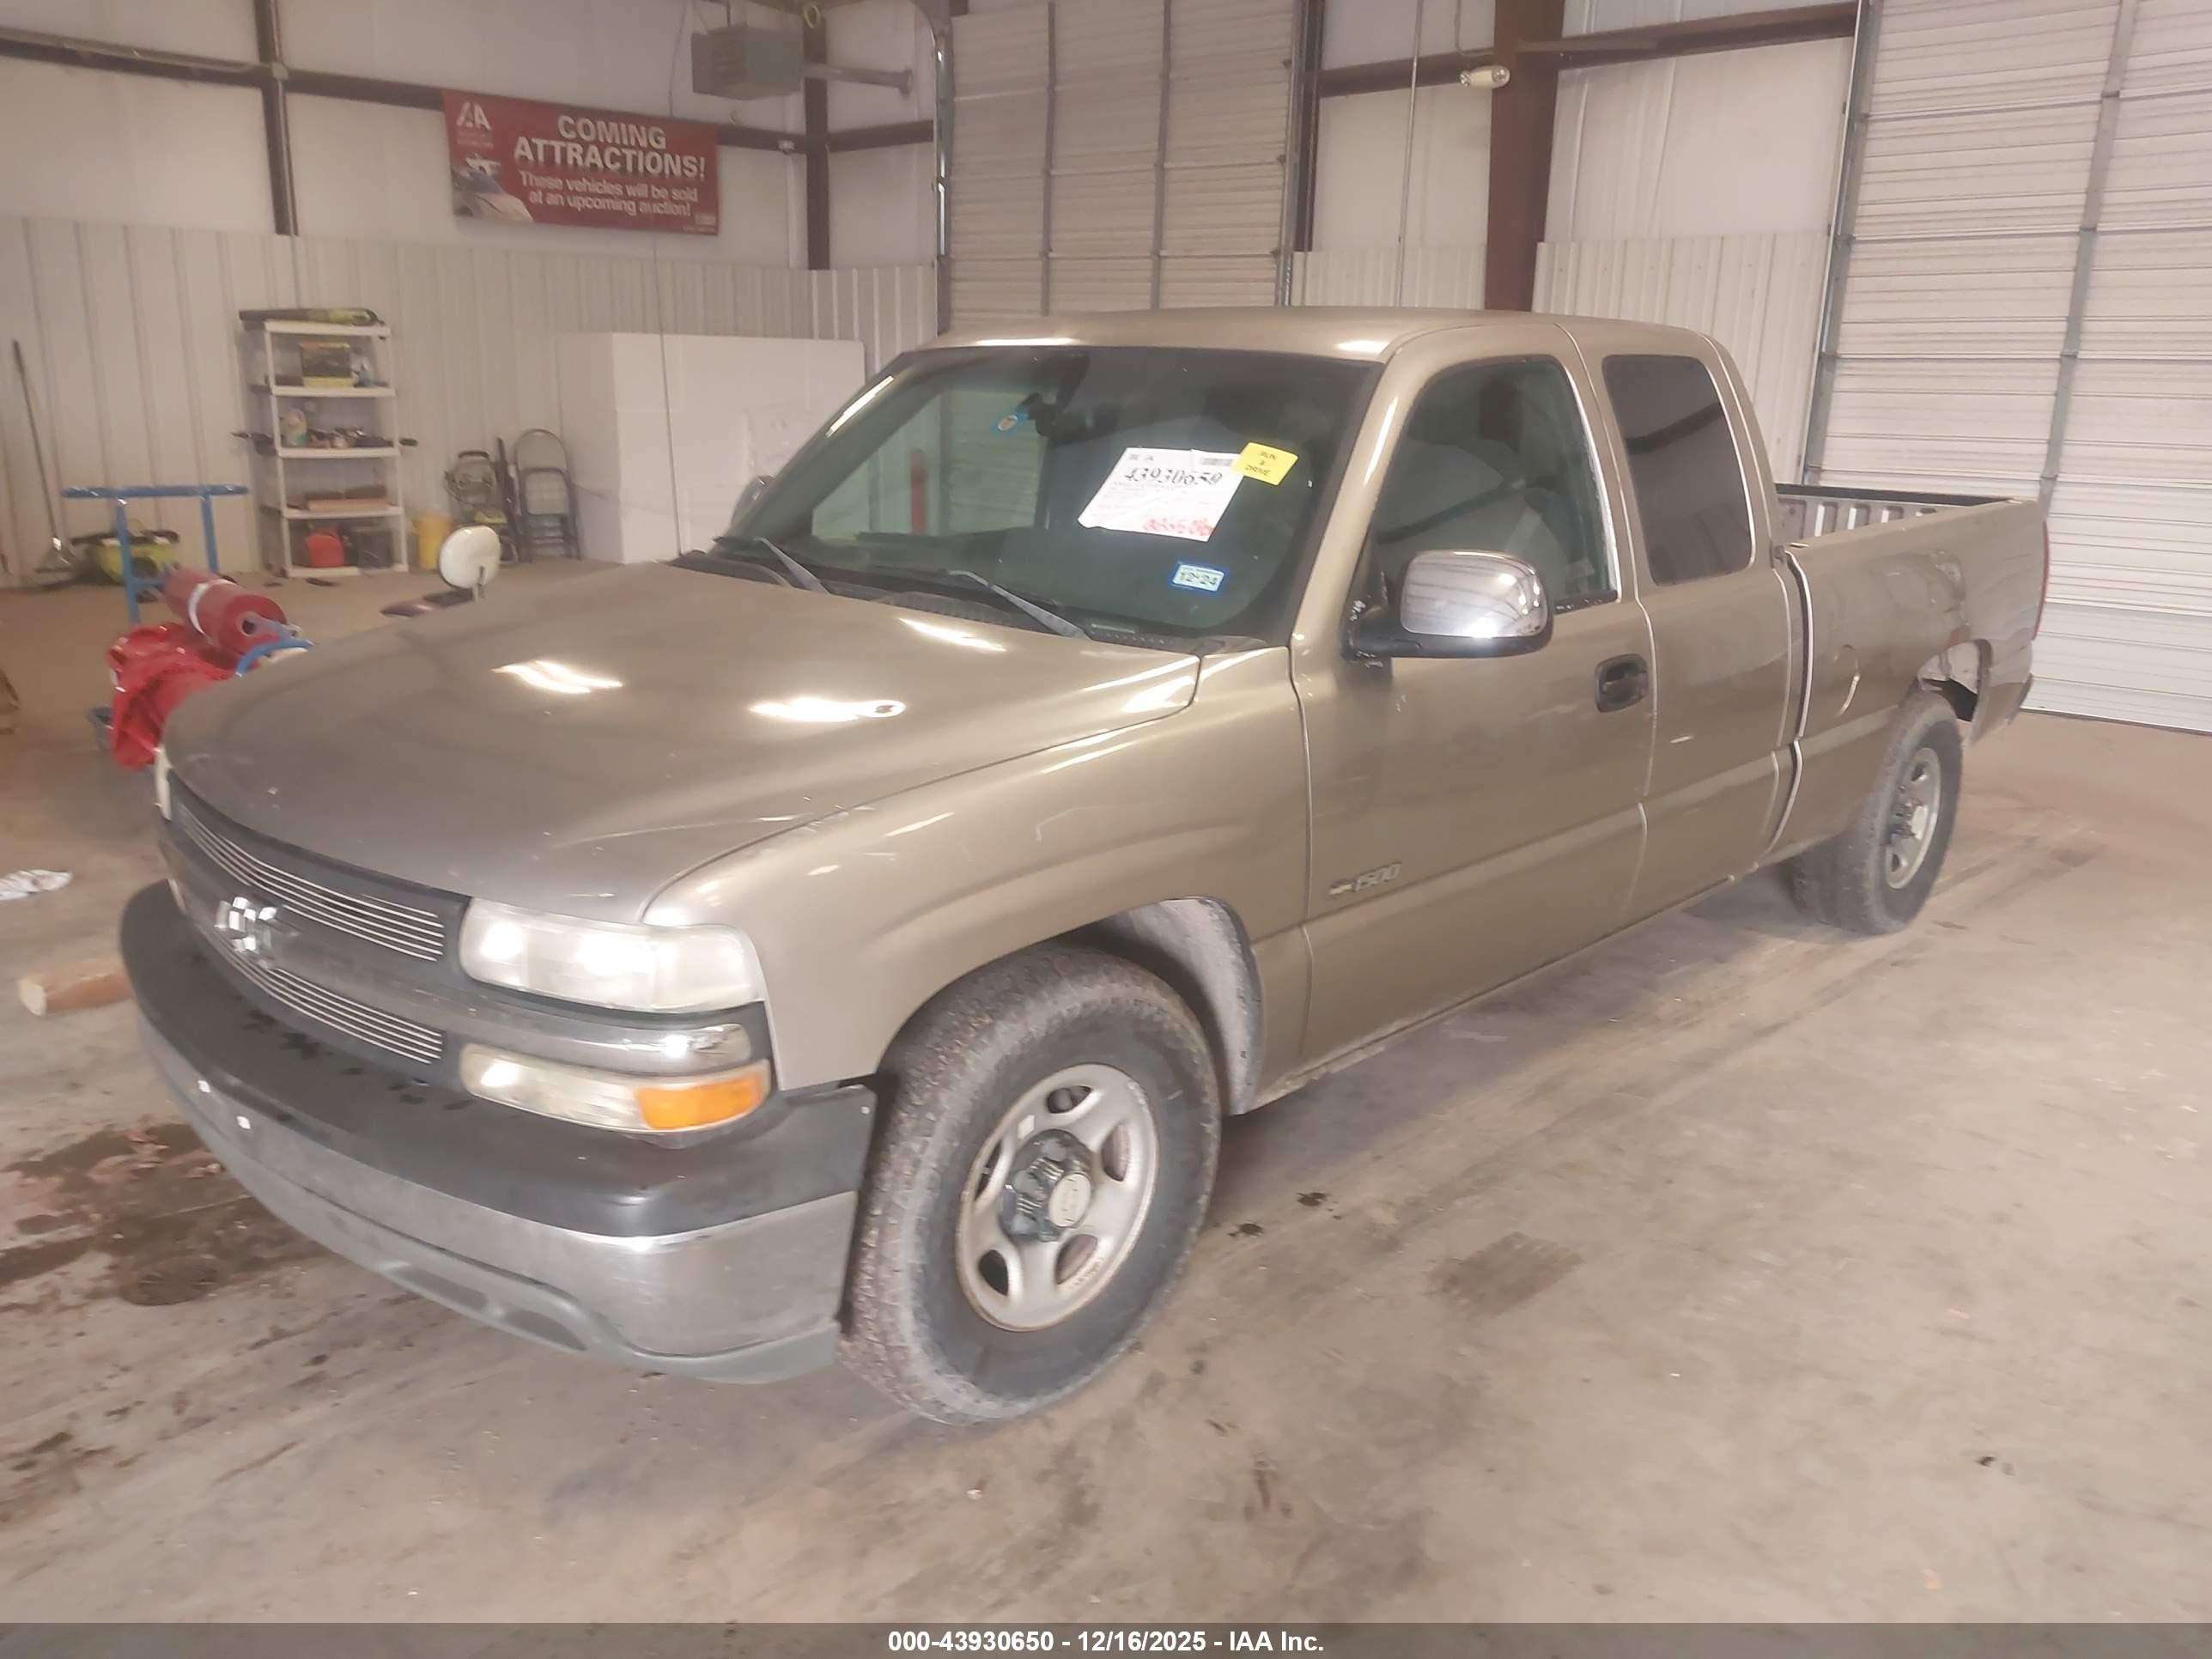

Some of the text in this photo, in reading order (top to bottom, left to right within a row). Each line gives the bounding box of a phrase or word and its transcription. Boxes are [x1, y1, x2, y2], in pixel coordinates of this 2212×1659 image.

[557, 114, 667, 149] COMING
[514, 136, 706, 179] ATTRACTIONS!
[519, 170, 698, 203] These vehicles will be sold
[529, 190, 691, 217] at an upcoming auction!
